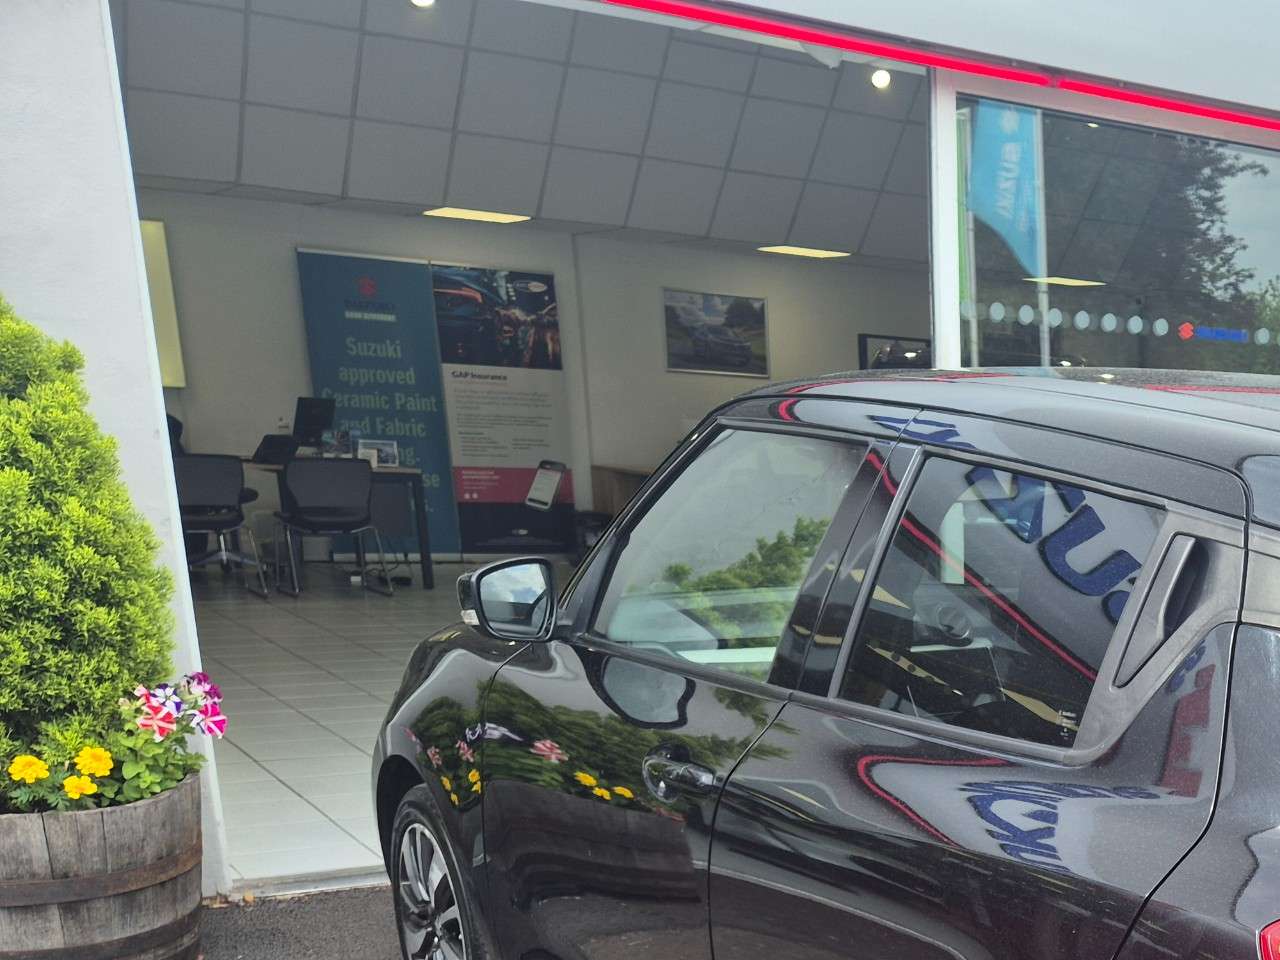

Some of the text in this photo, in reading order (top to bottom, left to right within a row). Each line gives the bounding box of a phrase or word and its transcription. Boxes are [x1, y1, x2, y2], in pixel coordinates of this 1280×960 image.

[345, 336, 402, 359] Suzuki
[339, 365, 416, 385] approved
[394, 392, 439, 412] Paint
[339, 415, 427, 437] and Fabric
